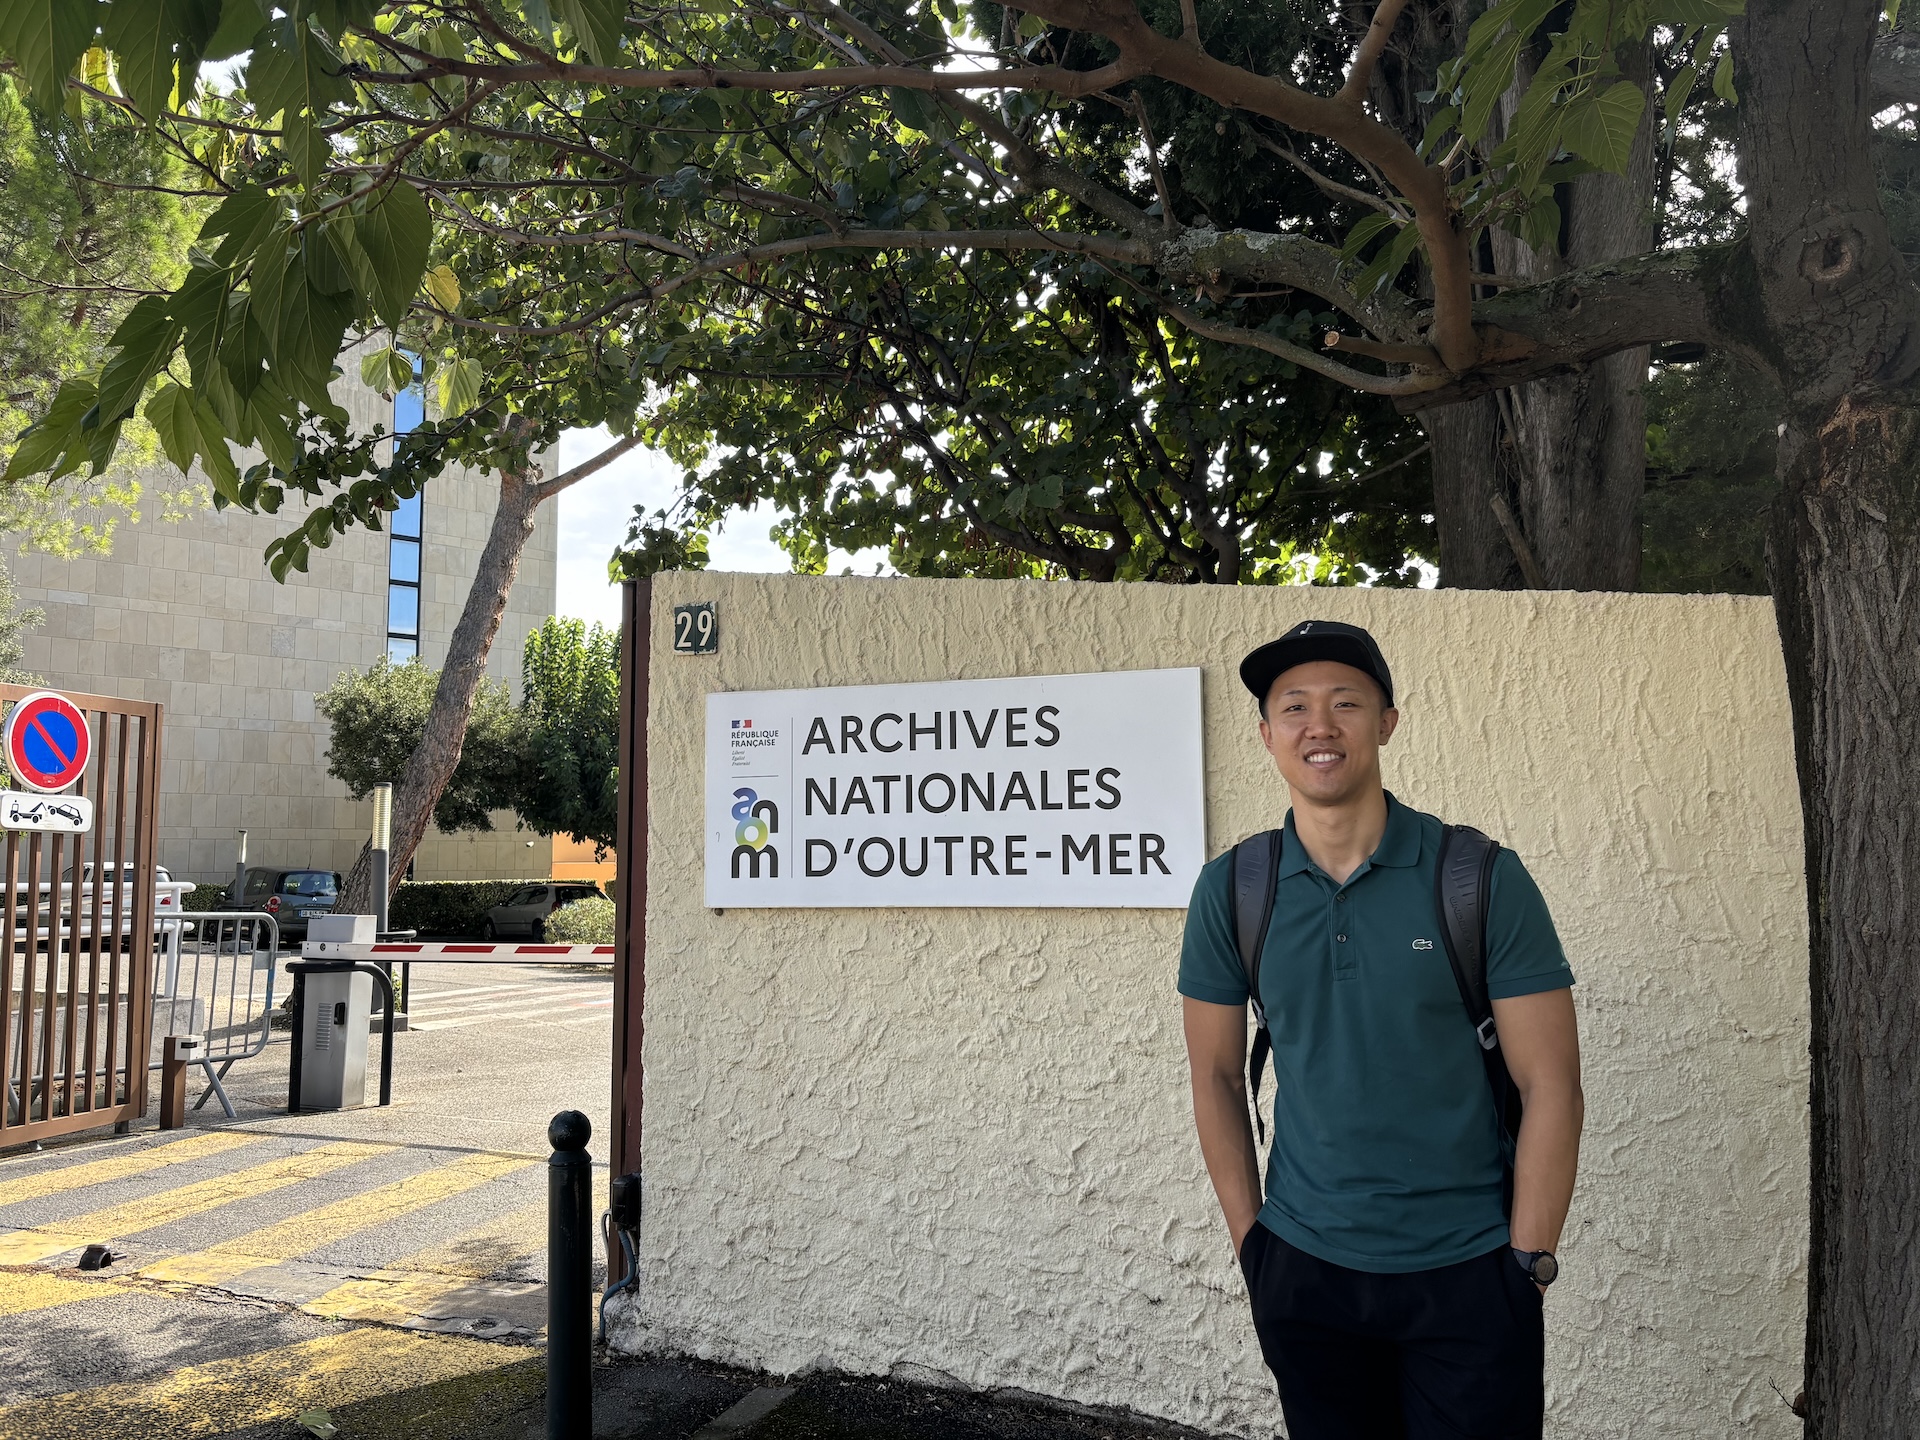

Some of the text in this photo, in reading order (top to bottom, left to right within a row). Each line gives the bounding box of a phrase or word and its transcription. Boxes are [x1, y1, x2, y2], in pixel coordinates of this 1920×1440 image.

[676, 610, 713, 648] 29
[731, 730, 779, 739] RÉPUBLIQUE
[731, 739, 776, 748] FRANÇAISE
[801, 705, 1061, 755] ARCHIVES
[805, 767, 1122, 815] NATIONALES
[805, 833, 1172, 878] D'OUTRE-MER
